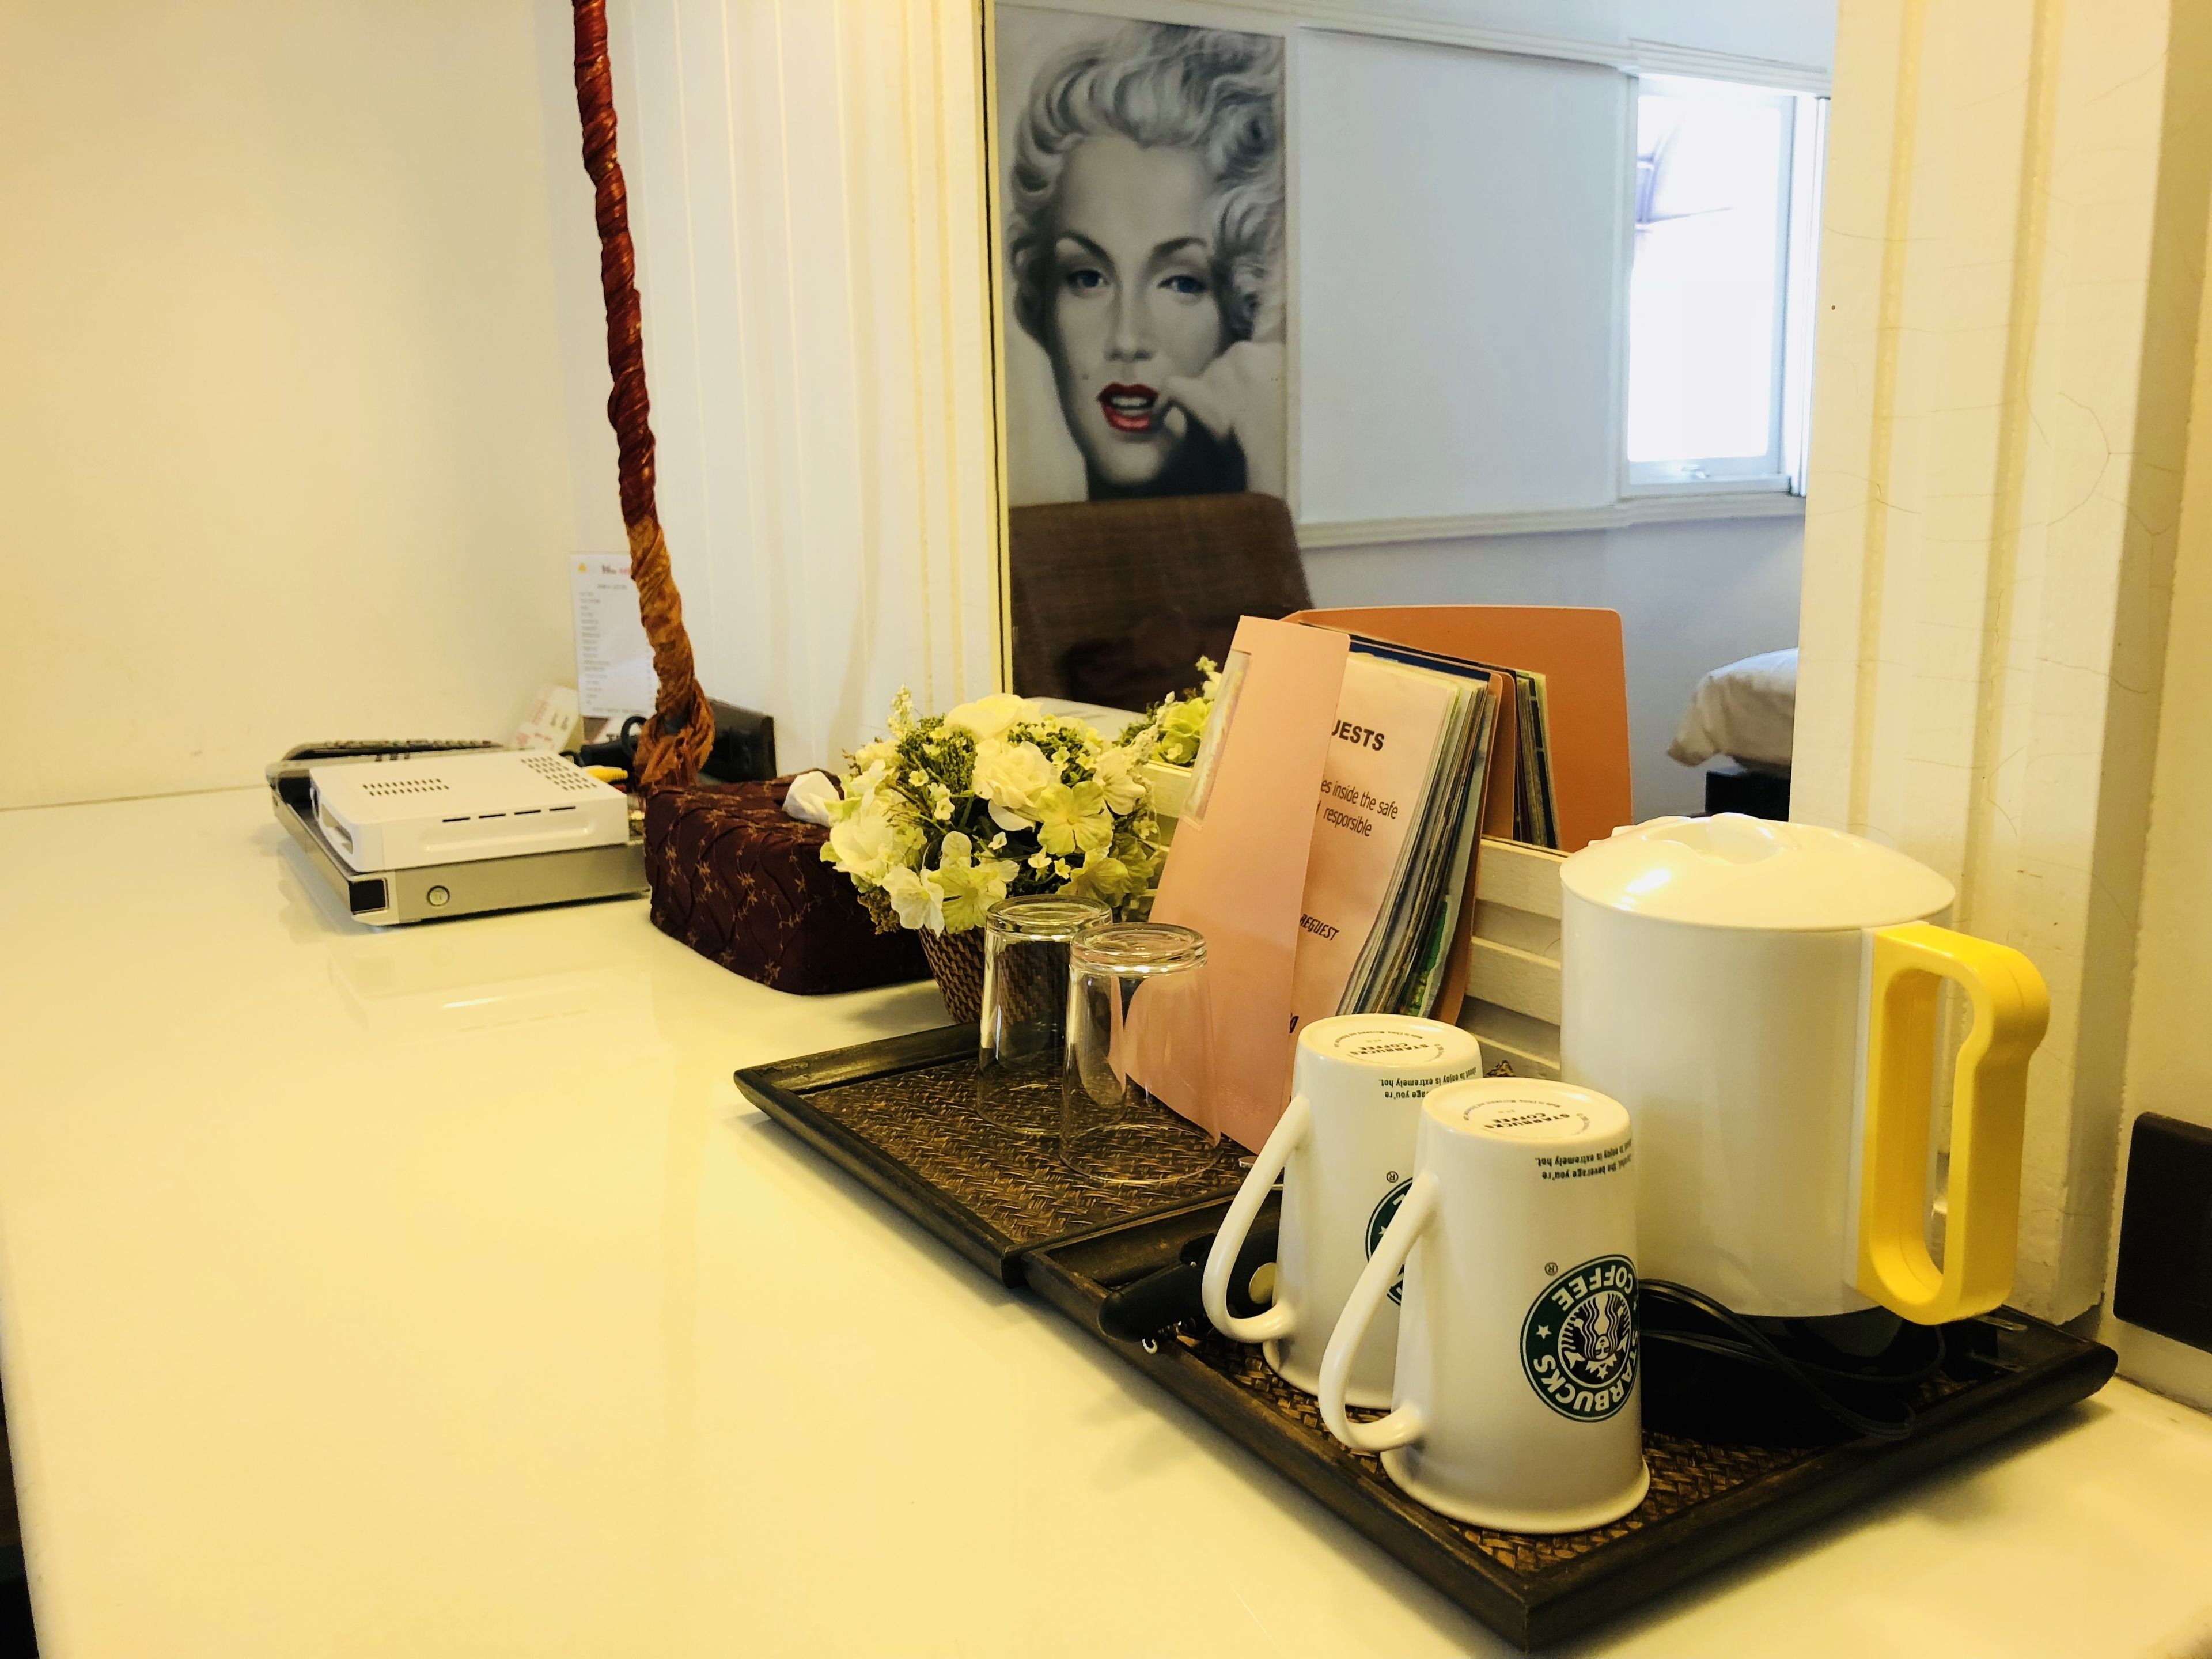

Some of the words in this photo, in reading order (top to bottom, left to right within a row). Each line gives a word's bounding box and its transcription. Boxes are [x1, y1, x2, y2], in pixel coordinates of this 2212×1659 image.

[1332, 781, 1358, 804] inside
[1360, 791, 1376, 810] the
[1377, 801, 1398, 819] safe
[1379, 1079, 1393, 1088] hot.
[1396, 1078, 1433, 1088] extremely
[1435, 1077, 1441, 1085] is
[1443, 1074, 1459, 1084] enjoy
[1385, 1090, 1409, 1100] you're
[1411, 1090, 1429, 1099] age
[1535, 1157, 1552, 1167] hot.
[1555, 1154, 1594, 1167] extremely
[1597, 1153, 1603, 1161] is
[1542, 1169, 1570, 1181] you're
[1573, 1165, 1606, 1178] beverage
[1552, 1264, 1634, 1312] COFFEE
[1533, 1330, 1639, 1412] STARBUCKS
